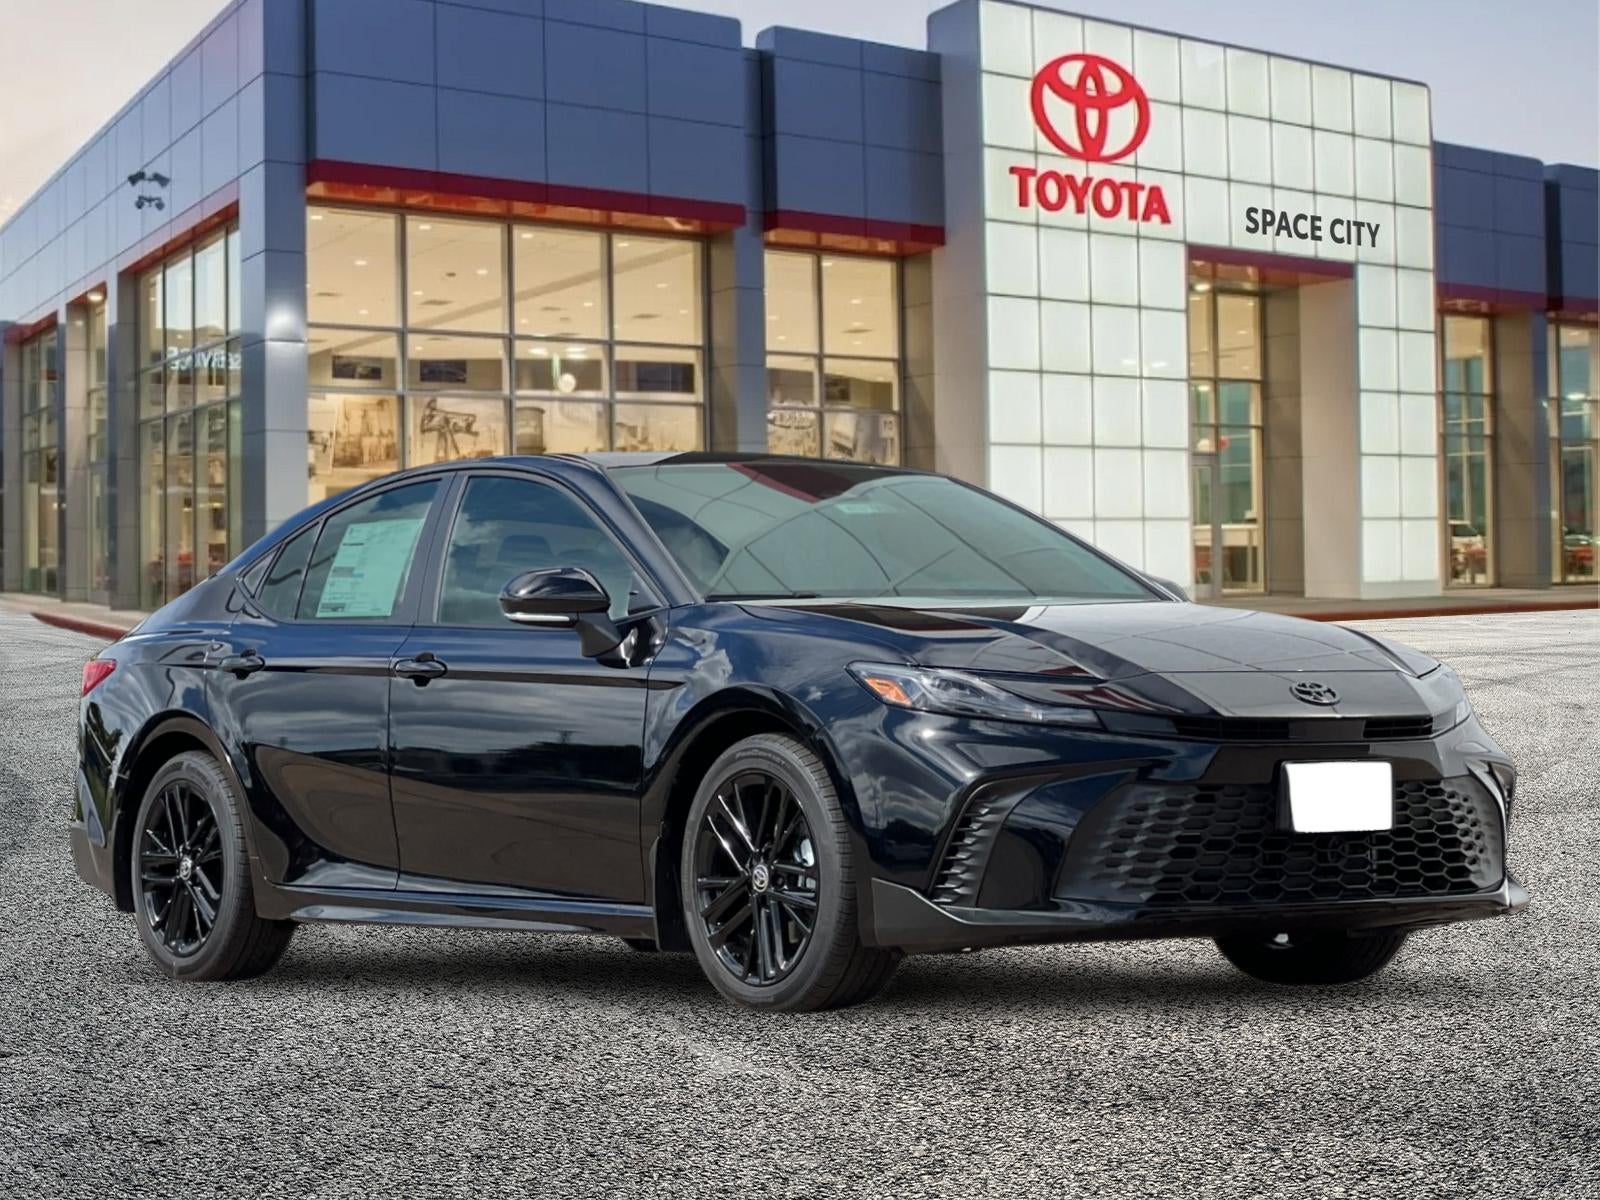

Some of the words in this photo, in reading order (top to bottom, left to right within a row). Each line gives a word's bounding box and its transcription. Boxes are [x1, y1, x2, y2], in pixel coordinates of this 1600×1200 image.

[1009, 166, 1171, 224] TOYOTA
[1245, 206, 1323, 242] SPACE
[1329, 217, 1381, 249] CITY
